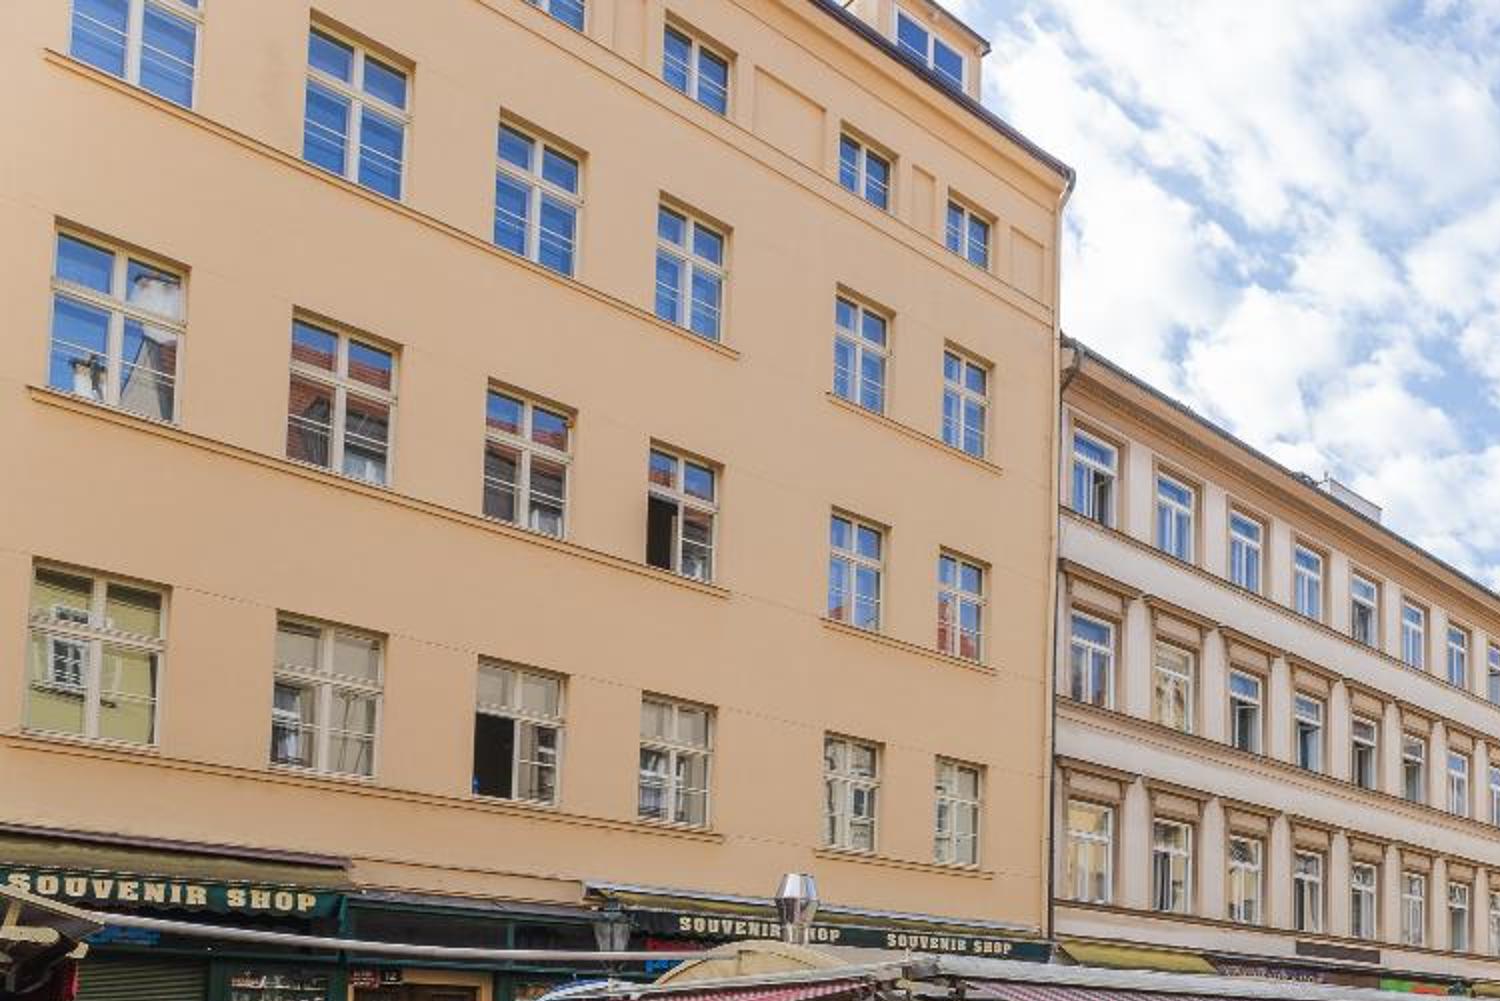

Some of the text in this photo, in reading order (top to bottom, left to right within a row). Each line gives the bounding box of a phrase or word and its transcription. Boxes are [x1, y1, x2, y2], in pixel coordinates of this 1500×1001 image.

[8, 873, 317, 912] SOUVENIR SHOP
[679, 916, 781, 937] SOUVENIR
[887, 933, 1012, 954] SOUVENIR SHOP
